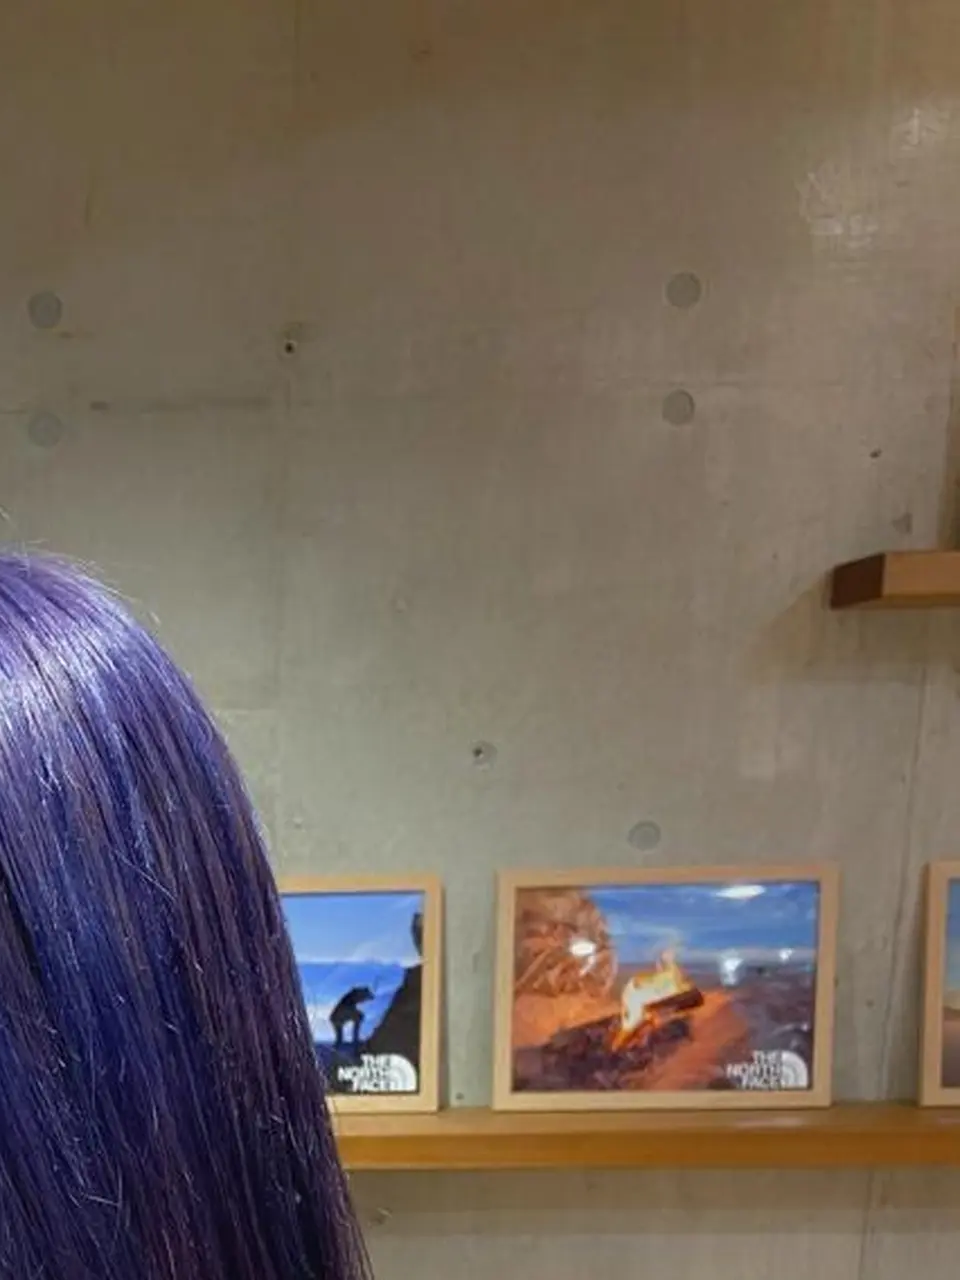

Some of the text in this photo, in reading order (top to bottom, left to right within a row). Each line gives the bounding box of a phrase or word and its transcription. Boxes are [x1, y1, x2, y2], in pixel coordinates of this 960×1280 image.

[361, 1054, 387, 1067] THE
[338, 1066, 389, 1080] NORTH
[352, 1079, 387, 1092] FACE
